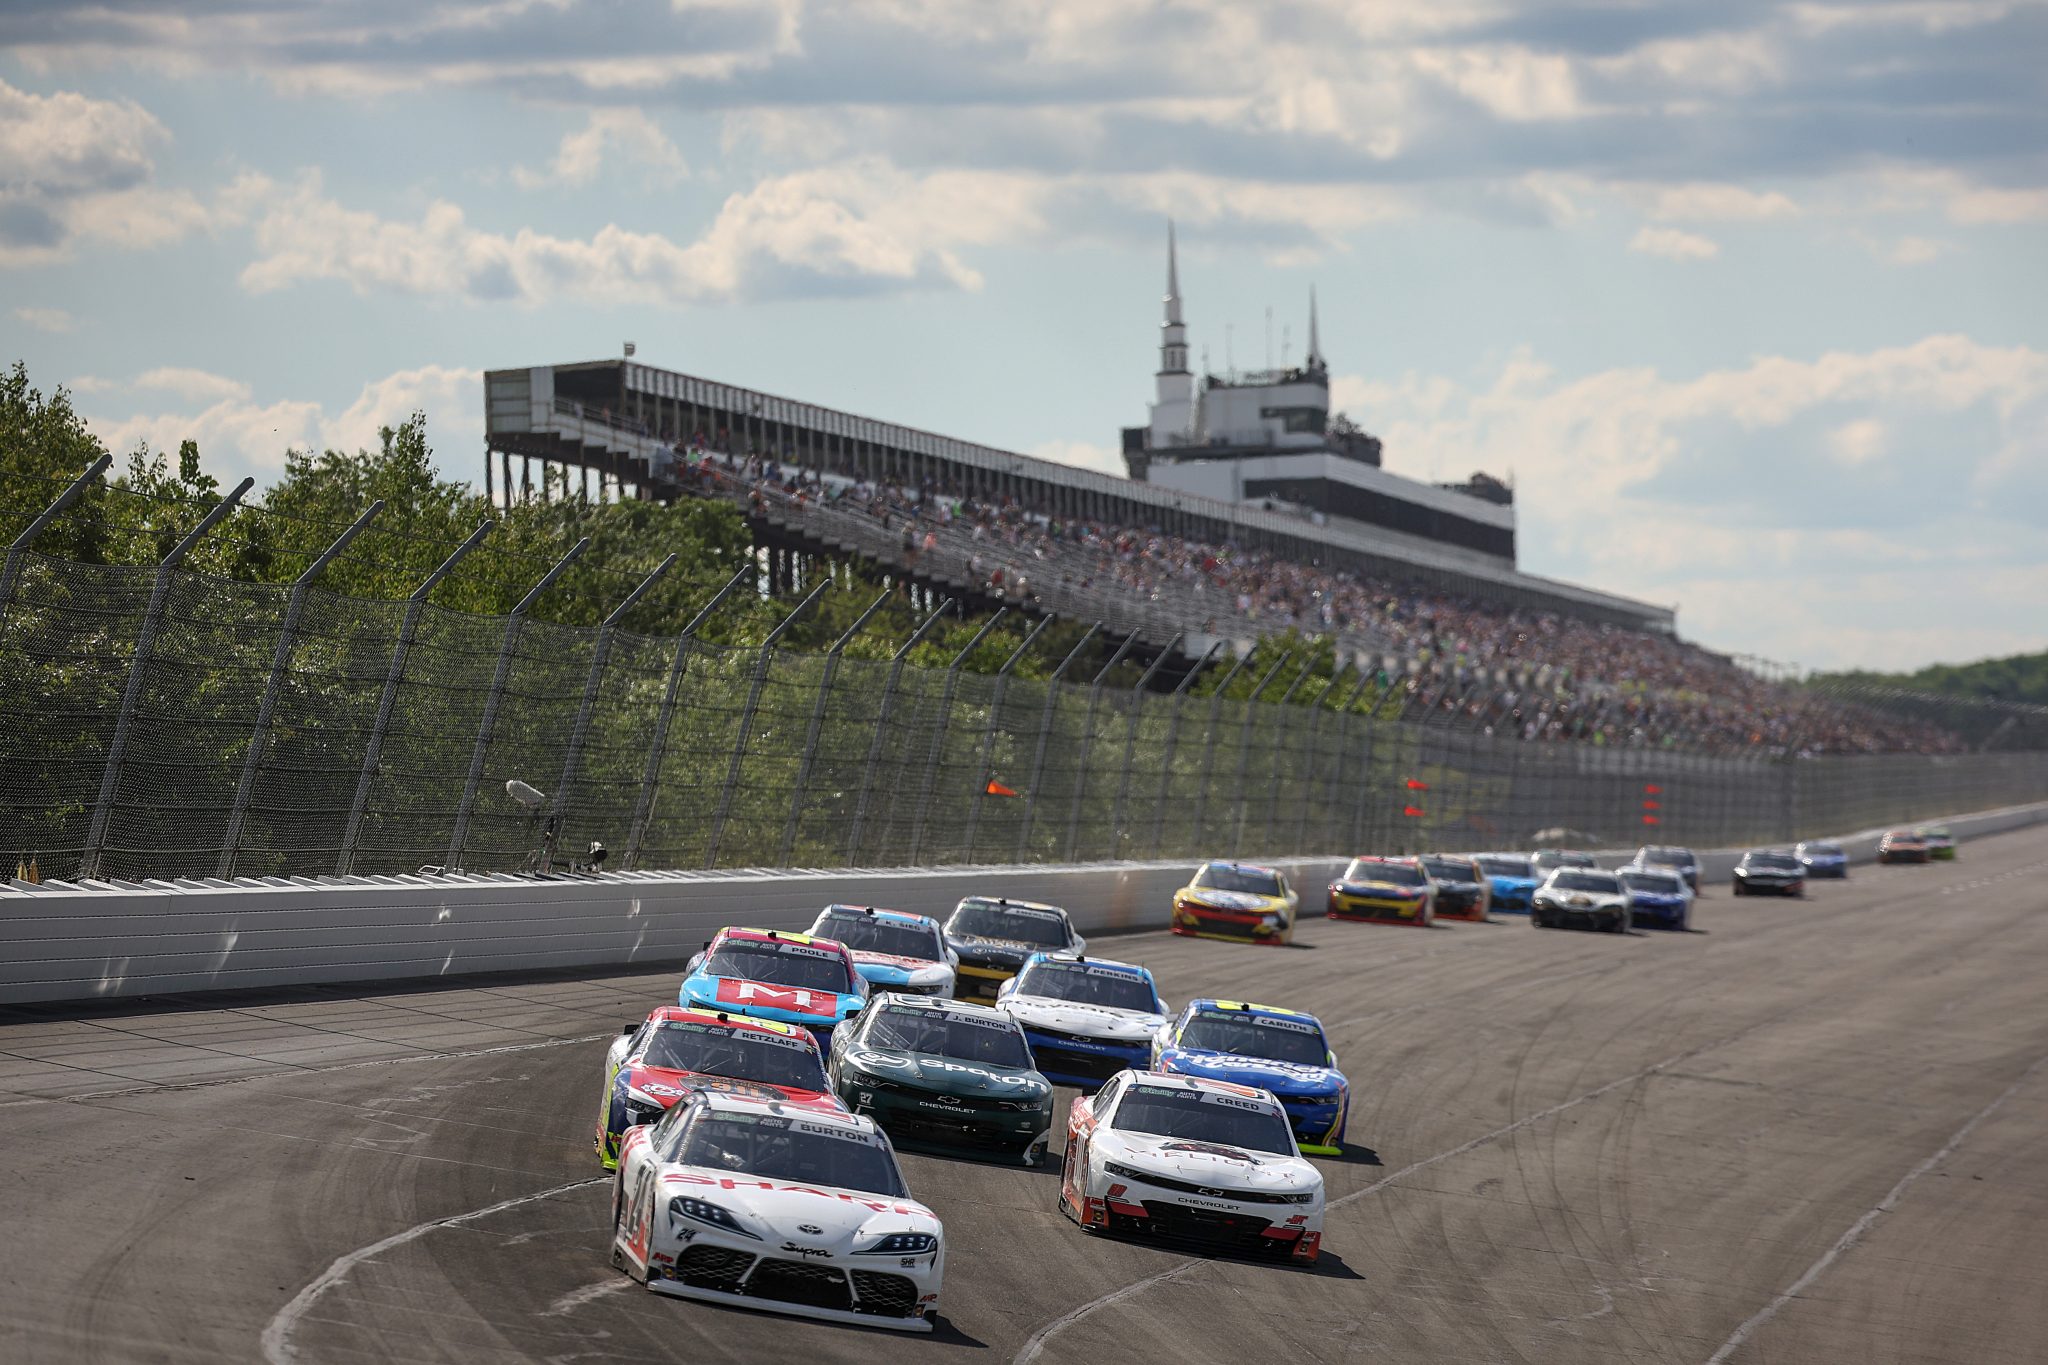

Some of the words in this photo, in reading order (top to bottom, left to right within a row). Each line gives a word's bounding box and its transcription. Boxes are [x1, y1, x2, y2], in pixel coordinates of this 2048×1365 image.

[899, 922, 922, 931] SIEG
[791, 946, 829, 958] POOLE
[1093, 968, 1139, 982] PERKINS
[736, 981, 813, 1009] M
[952, 1015, 963, 1023] J.
[966, 1016, 1007, 1031] BURTON
[1261, 1019, 1308, 1032] CARUTH
[742, 1031, 799, 1048] RETZLAFF
[1058, 1040, 1106, 1051] CHEVROLET
[858, 1092, 873, 1105] 27
[1216, 1097, 1260, 1111] CREED
[919, 1101, 977, 1114] CHEVROLET
[759, 1121, 786, 1129] PARTS
[800, 1123, 868, 1143] BURTON
[1177, 1196, 1241, 1211] CHEVROLET
[780, 1241, 835, 1260] Supra
